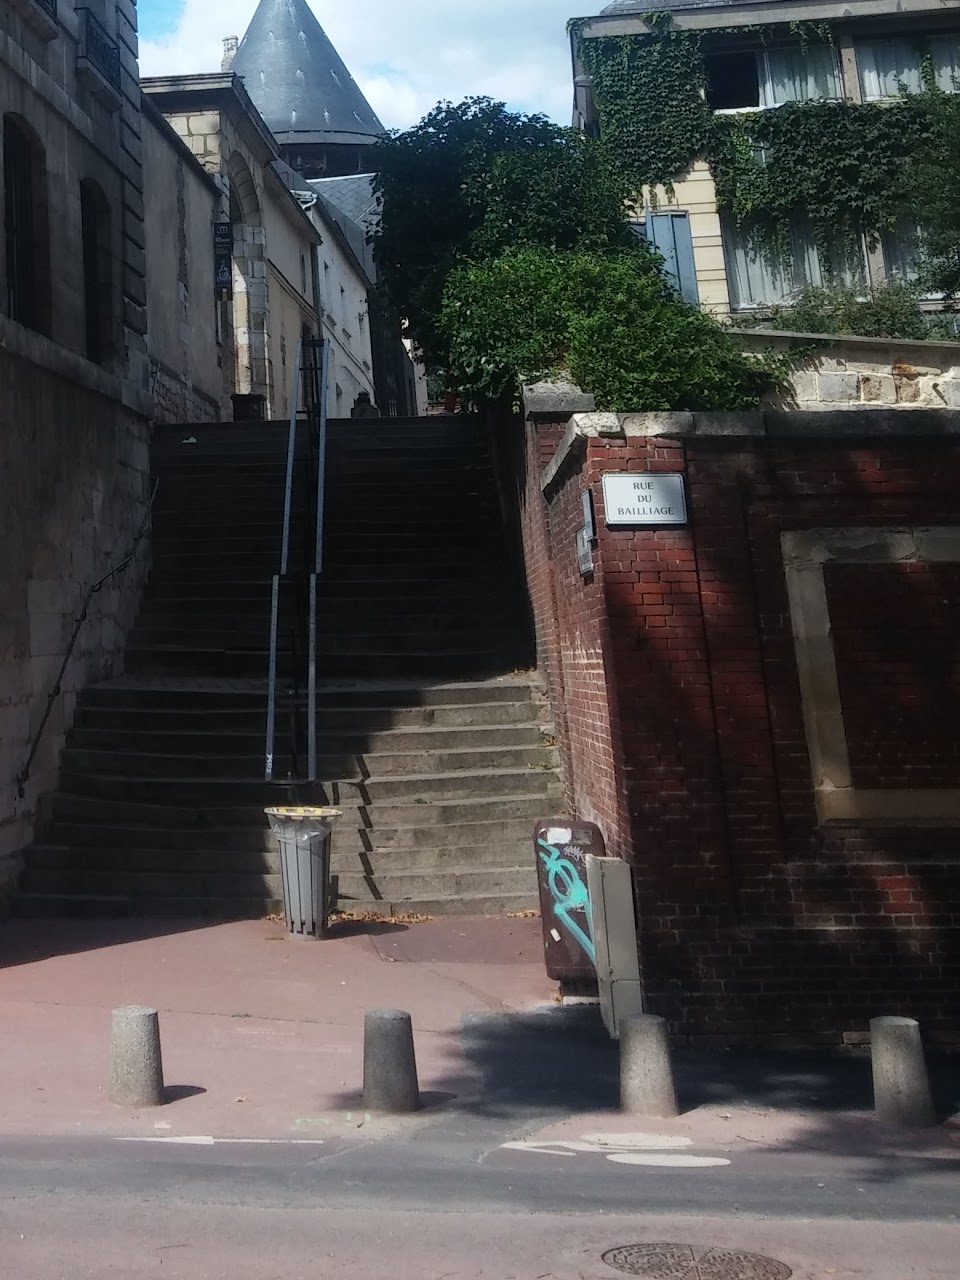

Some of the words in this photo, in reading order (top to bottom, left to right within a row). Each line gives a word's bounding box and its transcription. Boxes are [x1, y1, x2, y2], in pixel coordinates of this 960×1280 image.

[632, 481, 655, 491] RUE
[637, 494, 652, 503] DU
[617, 506, 675, 516] BAILLIAGE
